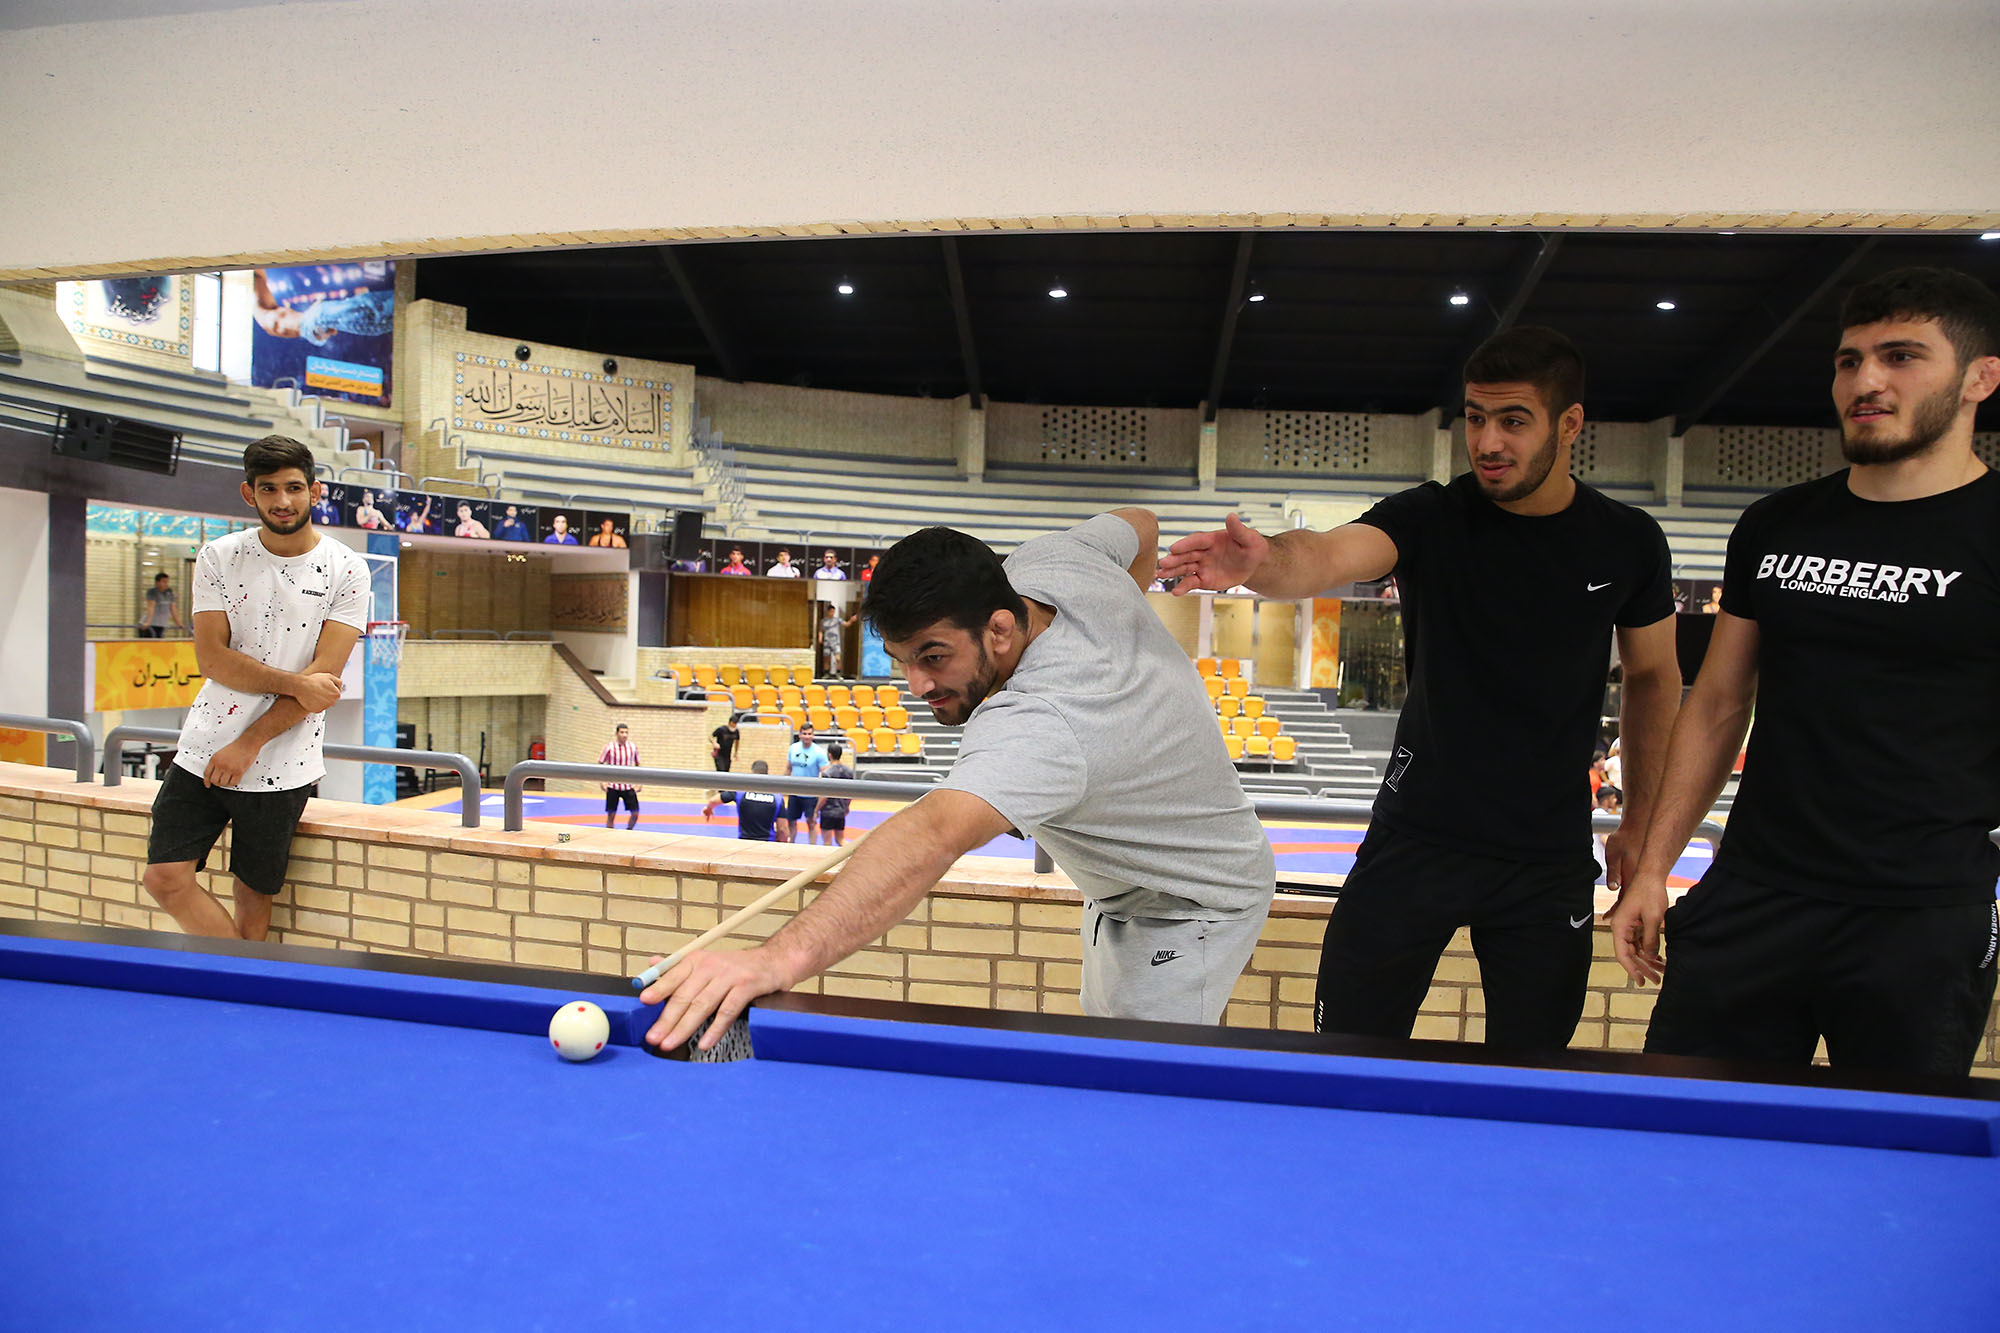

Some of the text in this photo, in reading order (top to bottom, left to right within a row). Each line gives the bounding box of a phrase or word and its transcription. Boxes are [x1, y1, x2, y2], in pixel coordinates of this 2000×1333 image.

[1756, 554, 1963, 597] BURBERRY
[1780, 578, 1910, 604] LONDON ENGLAND
[133, 661, 178, 688] ایران
[1154, 949, 1177, 960] NIKE
